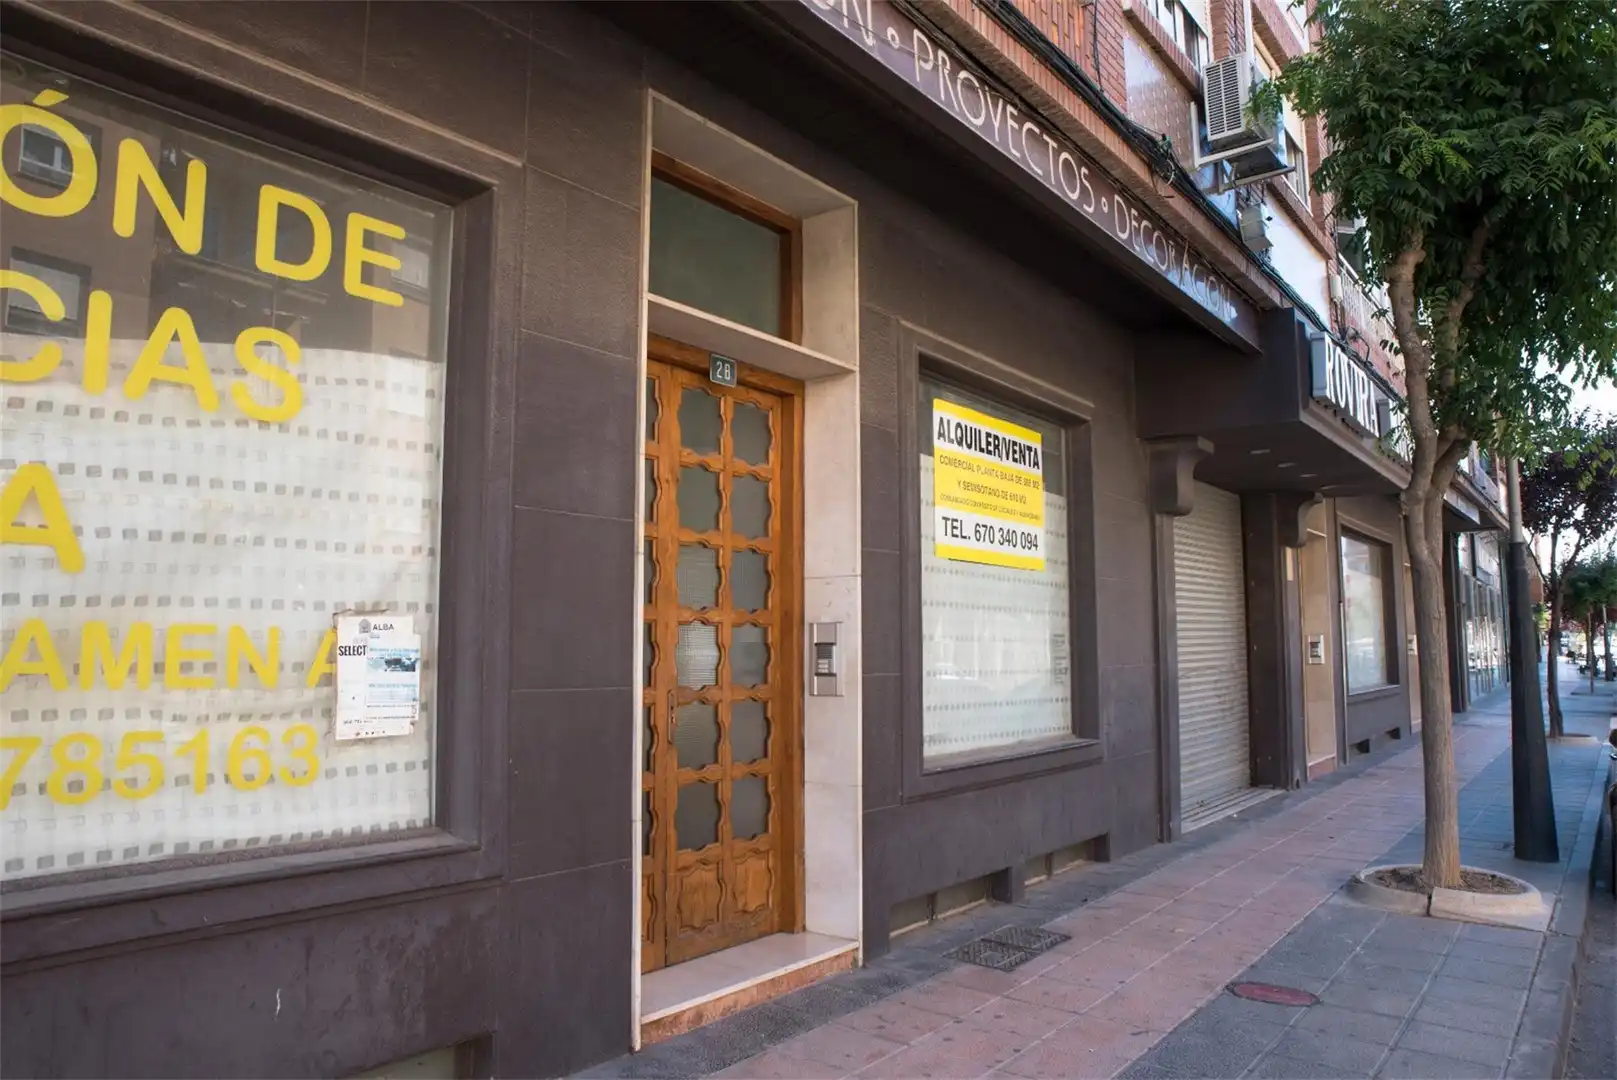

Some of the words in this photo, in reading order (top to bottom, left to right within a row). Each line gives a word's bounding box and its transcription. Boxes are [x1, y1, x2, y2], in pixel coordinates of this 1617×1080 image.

[912, 29, 1095, 214] PROYECTOS
[0, 88, 207, 255] ÓN
[255, 184, 406, 307] DE
[1324, 332, 1380, 438] ROVIRA
[937, 416, 1040, 470] ALQUILER/VENTA
[939, 454, 976, 473] COMERCIAL
[0, 463, 85, 573] A
[942, 516, 971, 541] TEL.
[974, 522, 995, 544] 670
[998, 527, 1018, 548] 340
[1021, 531, 1039, 551] 094
[0, 618, 280, 691] AMEN
[338, 645, 367, 656] SELECT
[0, 724, 320, 811] 785163
